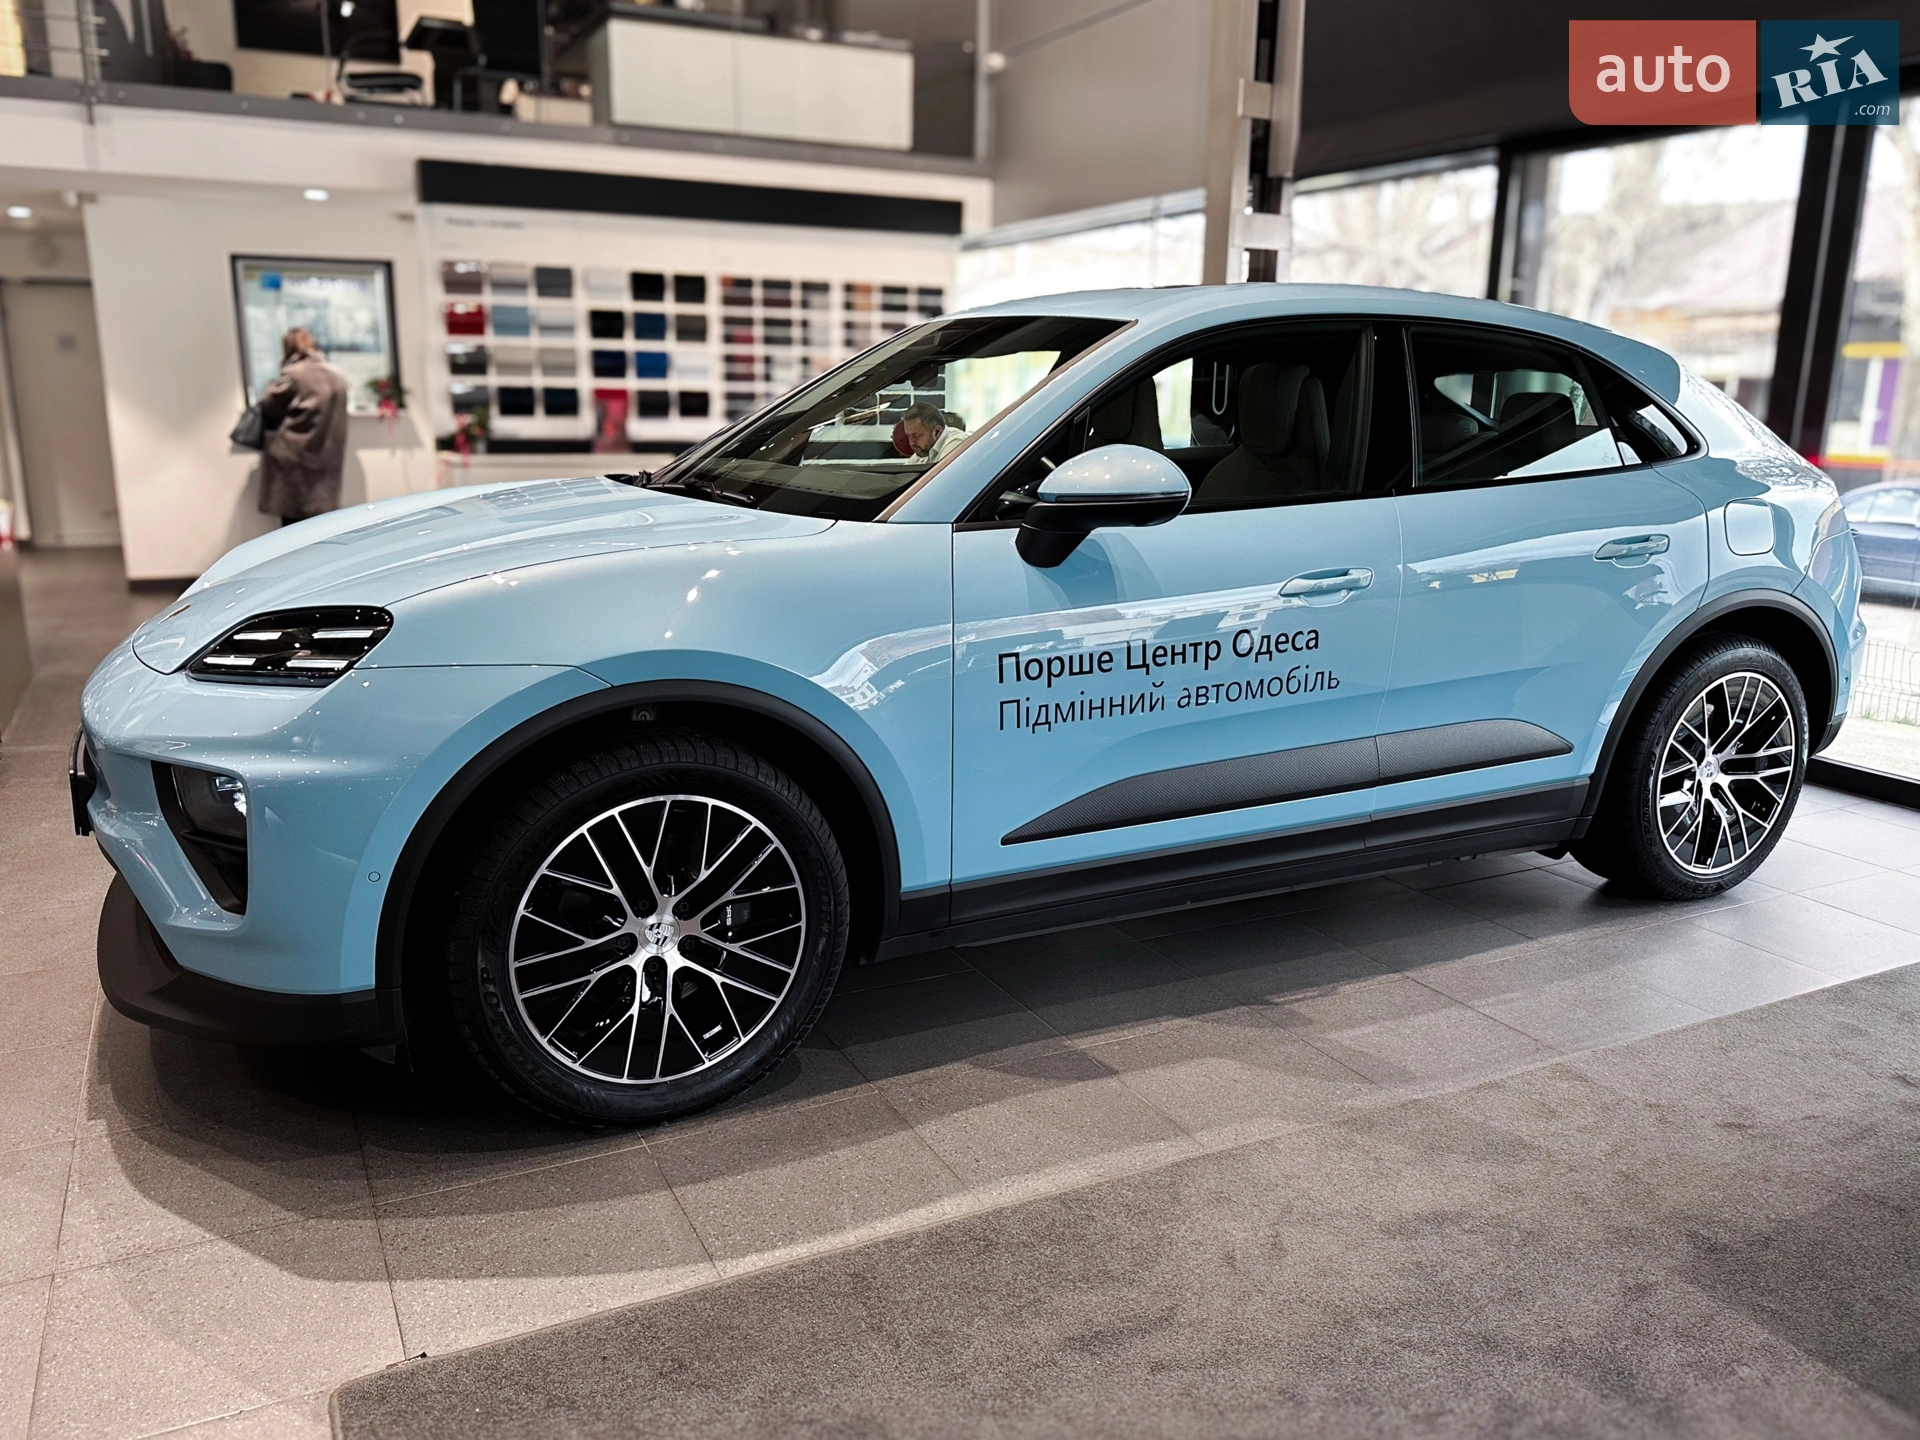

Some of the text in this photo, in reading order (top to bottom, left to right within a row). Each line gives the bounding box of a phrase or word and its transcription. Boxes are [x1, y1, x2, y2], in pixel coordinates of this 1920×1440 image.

[998, 628, 1320, 688] Порше Центр Одеса
[999, 664, 1341, 735] Підмінний автомобіль
[481, 966, 548, 1085] DUNLOP
